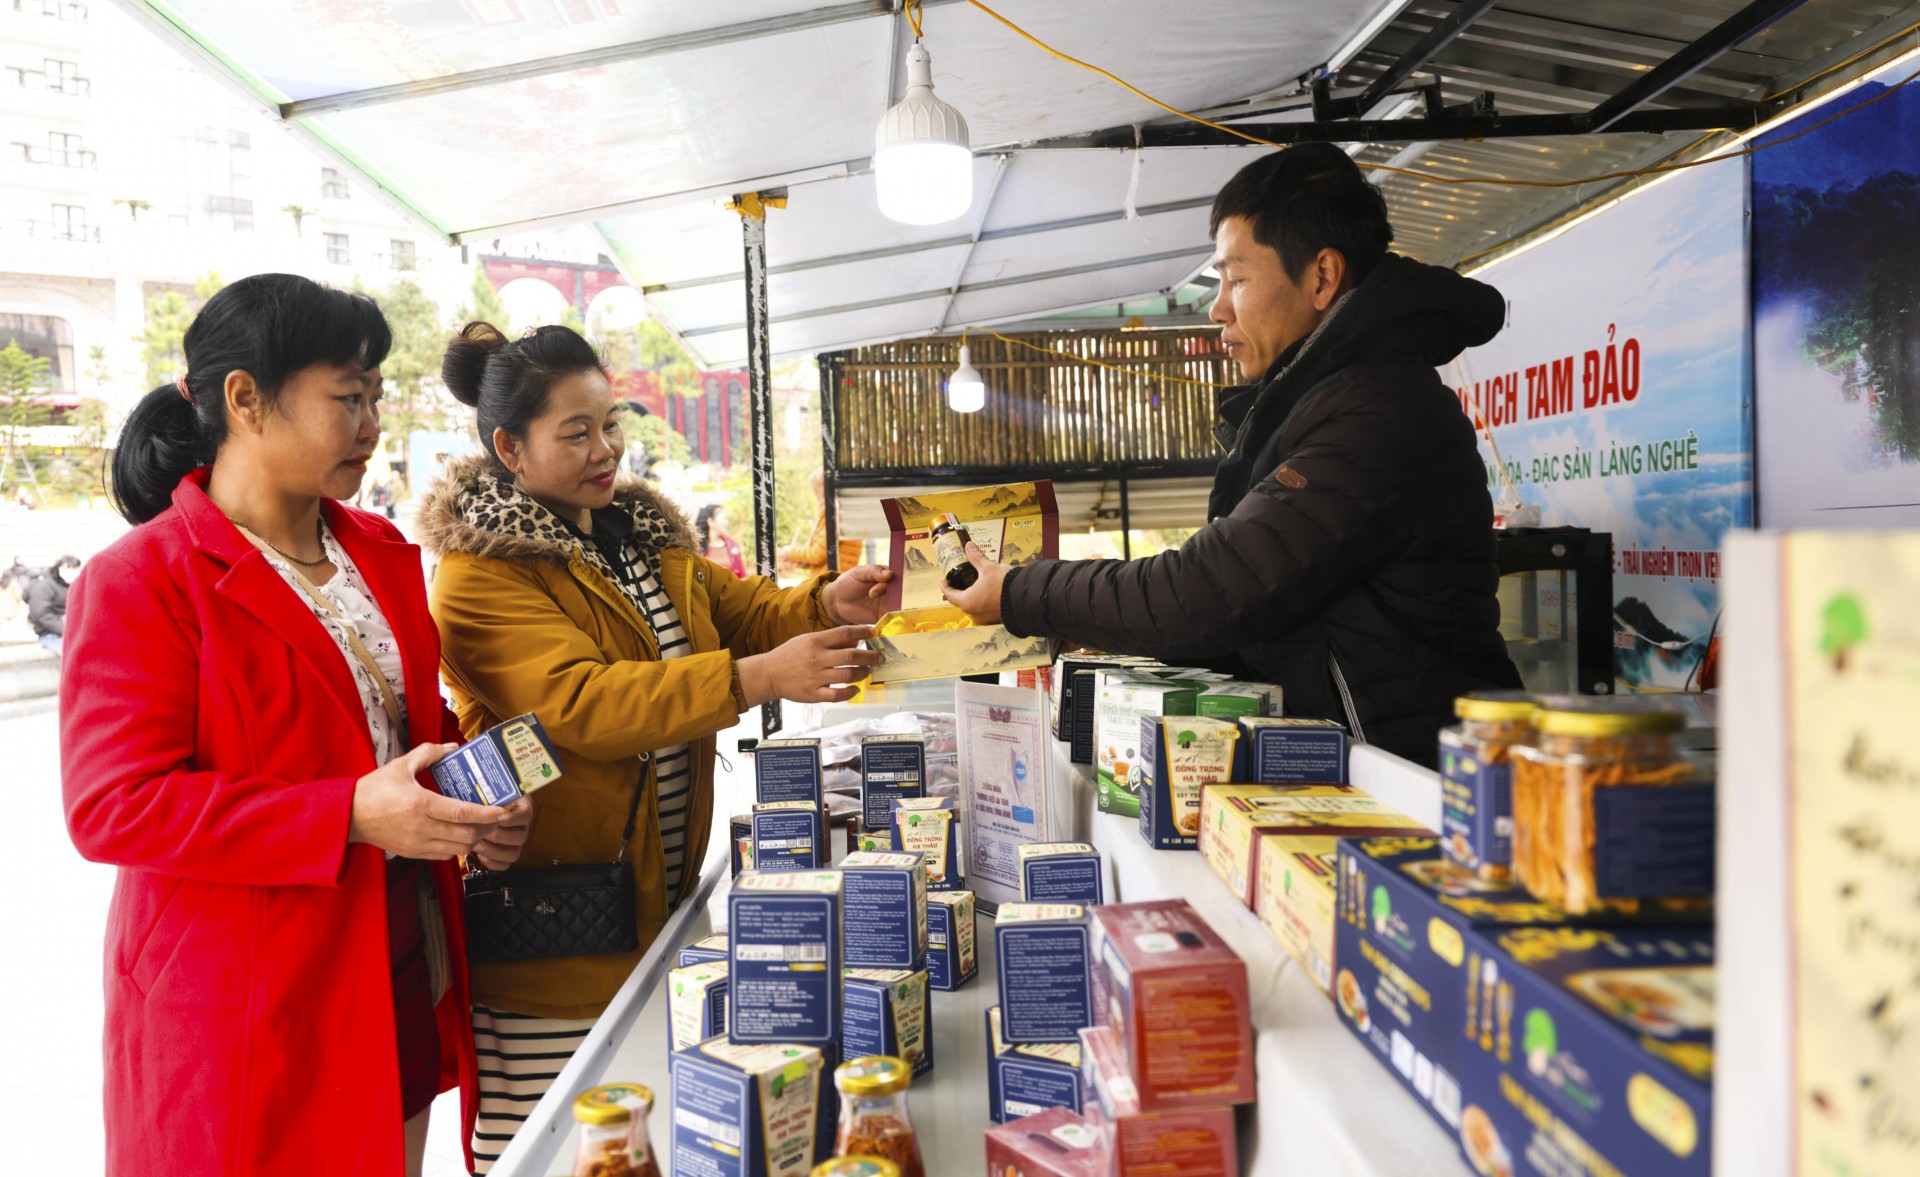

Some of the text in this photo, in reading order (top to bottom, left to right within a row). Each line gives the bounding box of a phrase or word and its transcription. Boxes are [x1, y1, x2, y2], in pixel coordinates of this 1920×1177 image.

[1525, 355, 1574, 420] TAM
[1583, 322, 1640, 409] ĐẢO
[1532, 452, 1559, 489] ĐẶC
[1563, 446, 1592, 481] SẢN
[1600, 440, 1642, 477] LÀNG
[1647, 430, 1698, 473] NGHỀ
[1622, 542, 1640, 575] TRẢI
[1642, 545, 1675, 582] NGHIỆM
[1677, 551, 1702, 583] TRỌN
